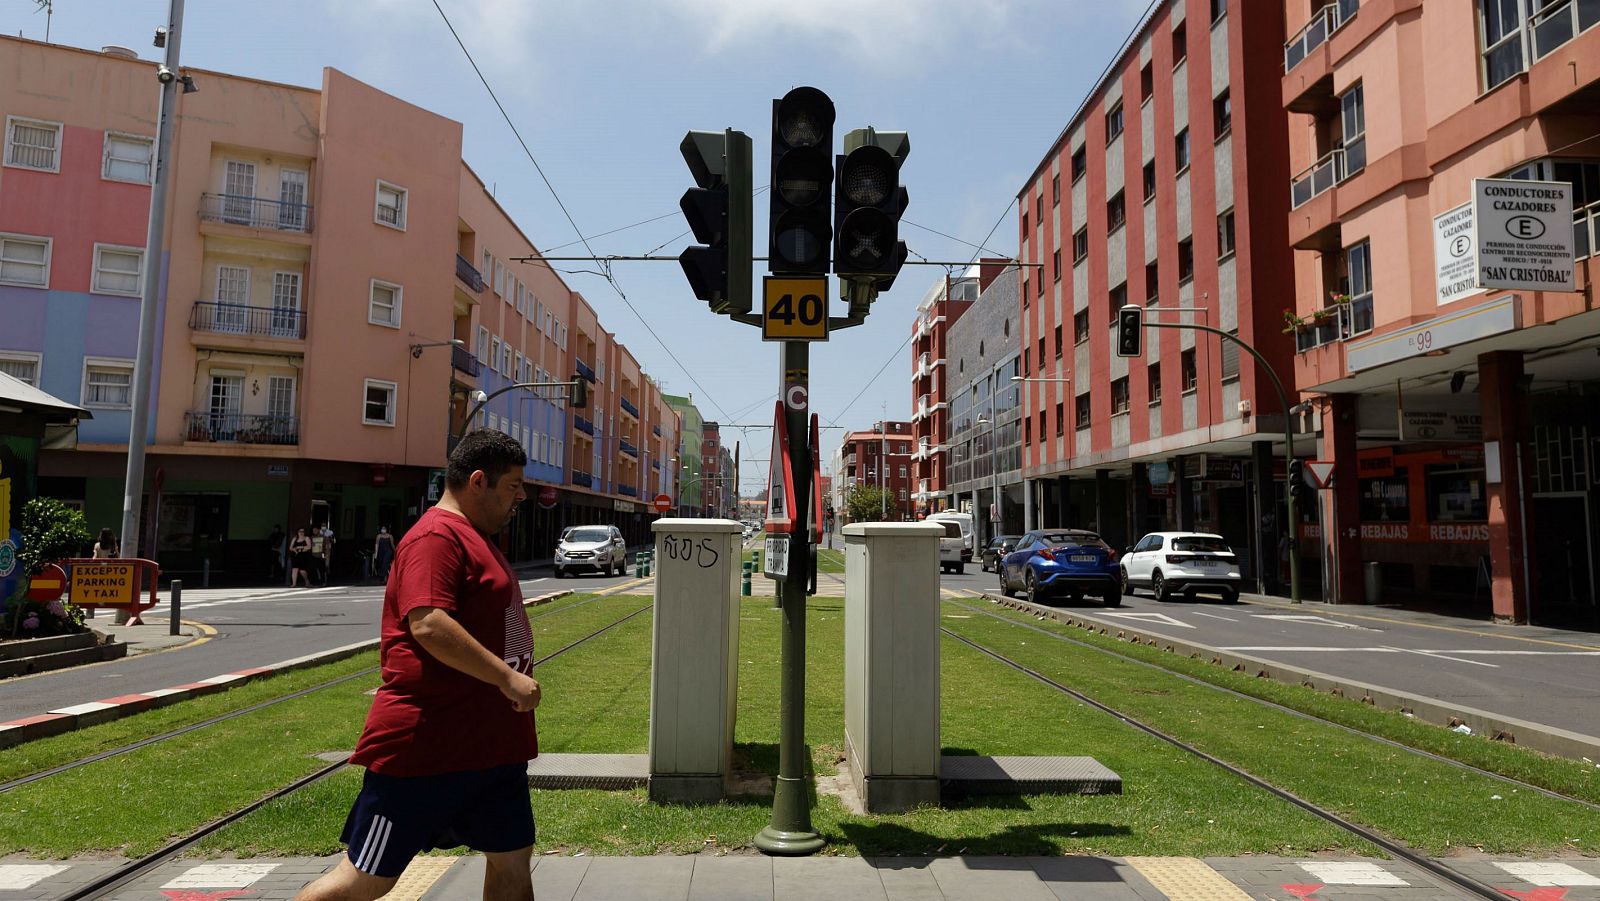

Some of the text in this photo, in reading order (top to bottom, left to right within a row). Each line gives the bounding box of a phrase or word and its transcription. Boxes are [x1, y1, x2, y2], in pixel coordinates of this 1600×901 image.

[1485, 187, 1563, 199] CONDUCTORES
[1493, 201, 1556, 212] CAZADORES
[1519, 220, 1531, 235] E
[1456, 239, 1464, 254] E
[1516, 250, 1570, 258] RECONOCIMIENTO
[768, 294, 823, 326] 40
[1417, 330, 1432, 351] 99
[786, 385, 807, 410] C
[1361, 525, 1408, 539] REBAJAS
[1430, 525, 1489, 540] REBAJAS
[77, 567, 127, 576] EXCEPTO
[77, 579, 125, 587] PARKING
[83, 589, 119, 598] Y TAXI
